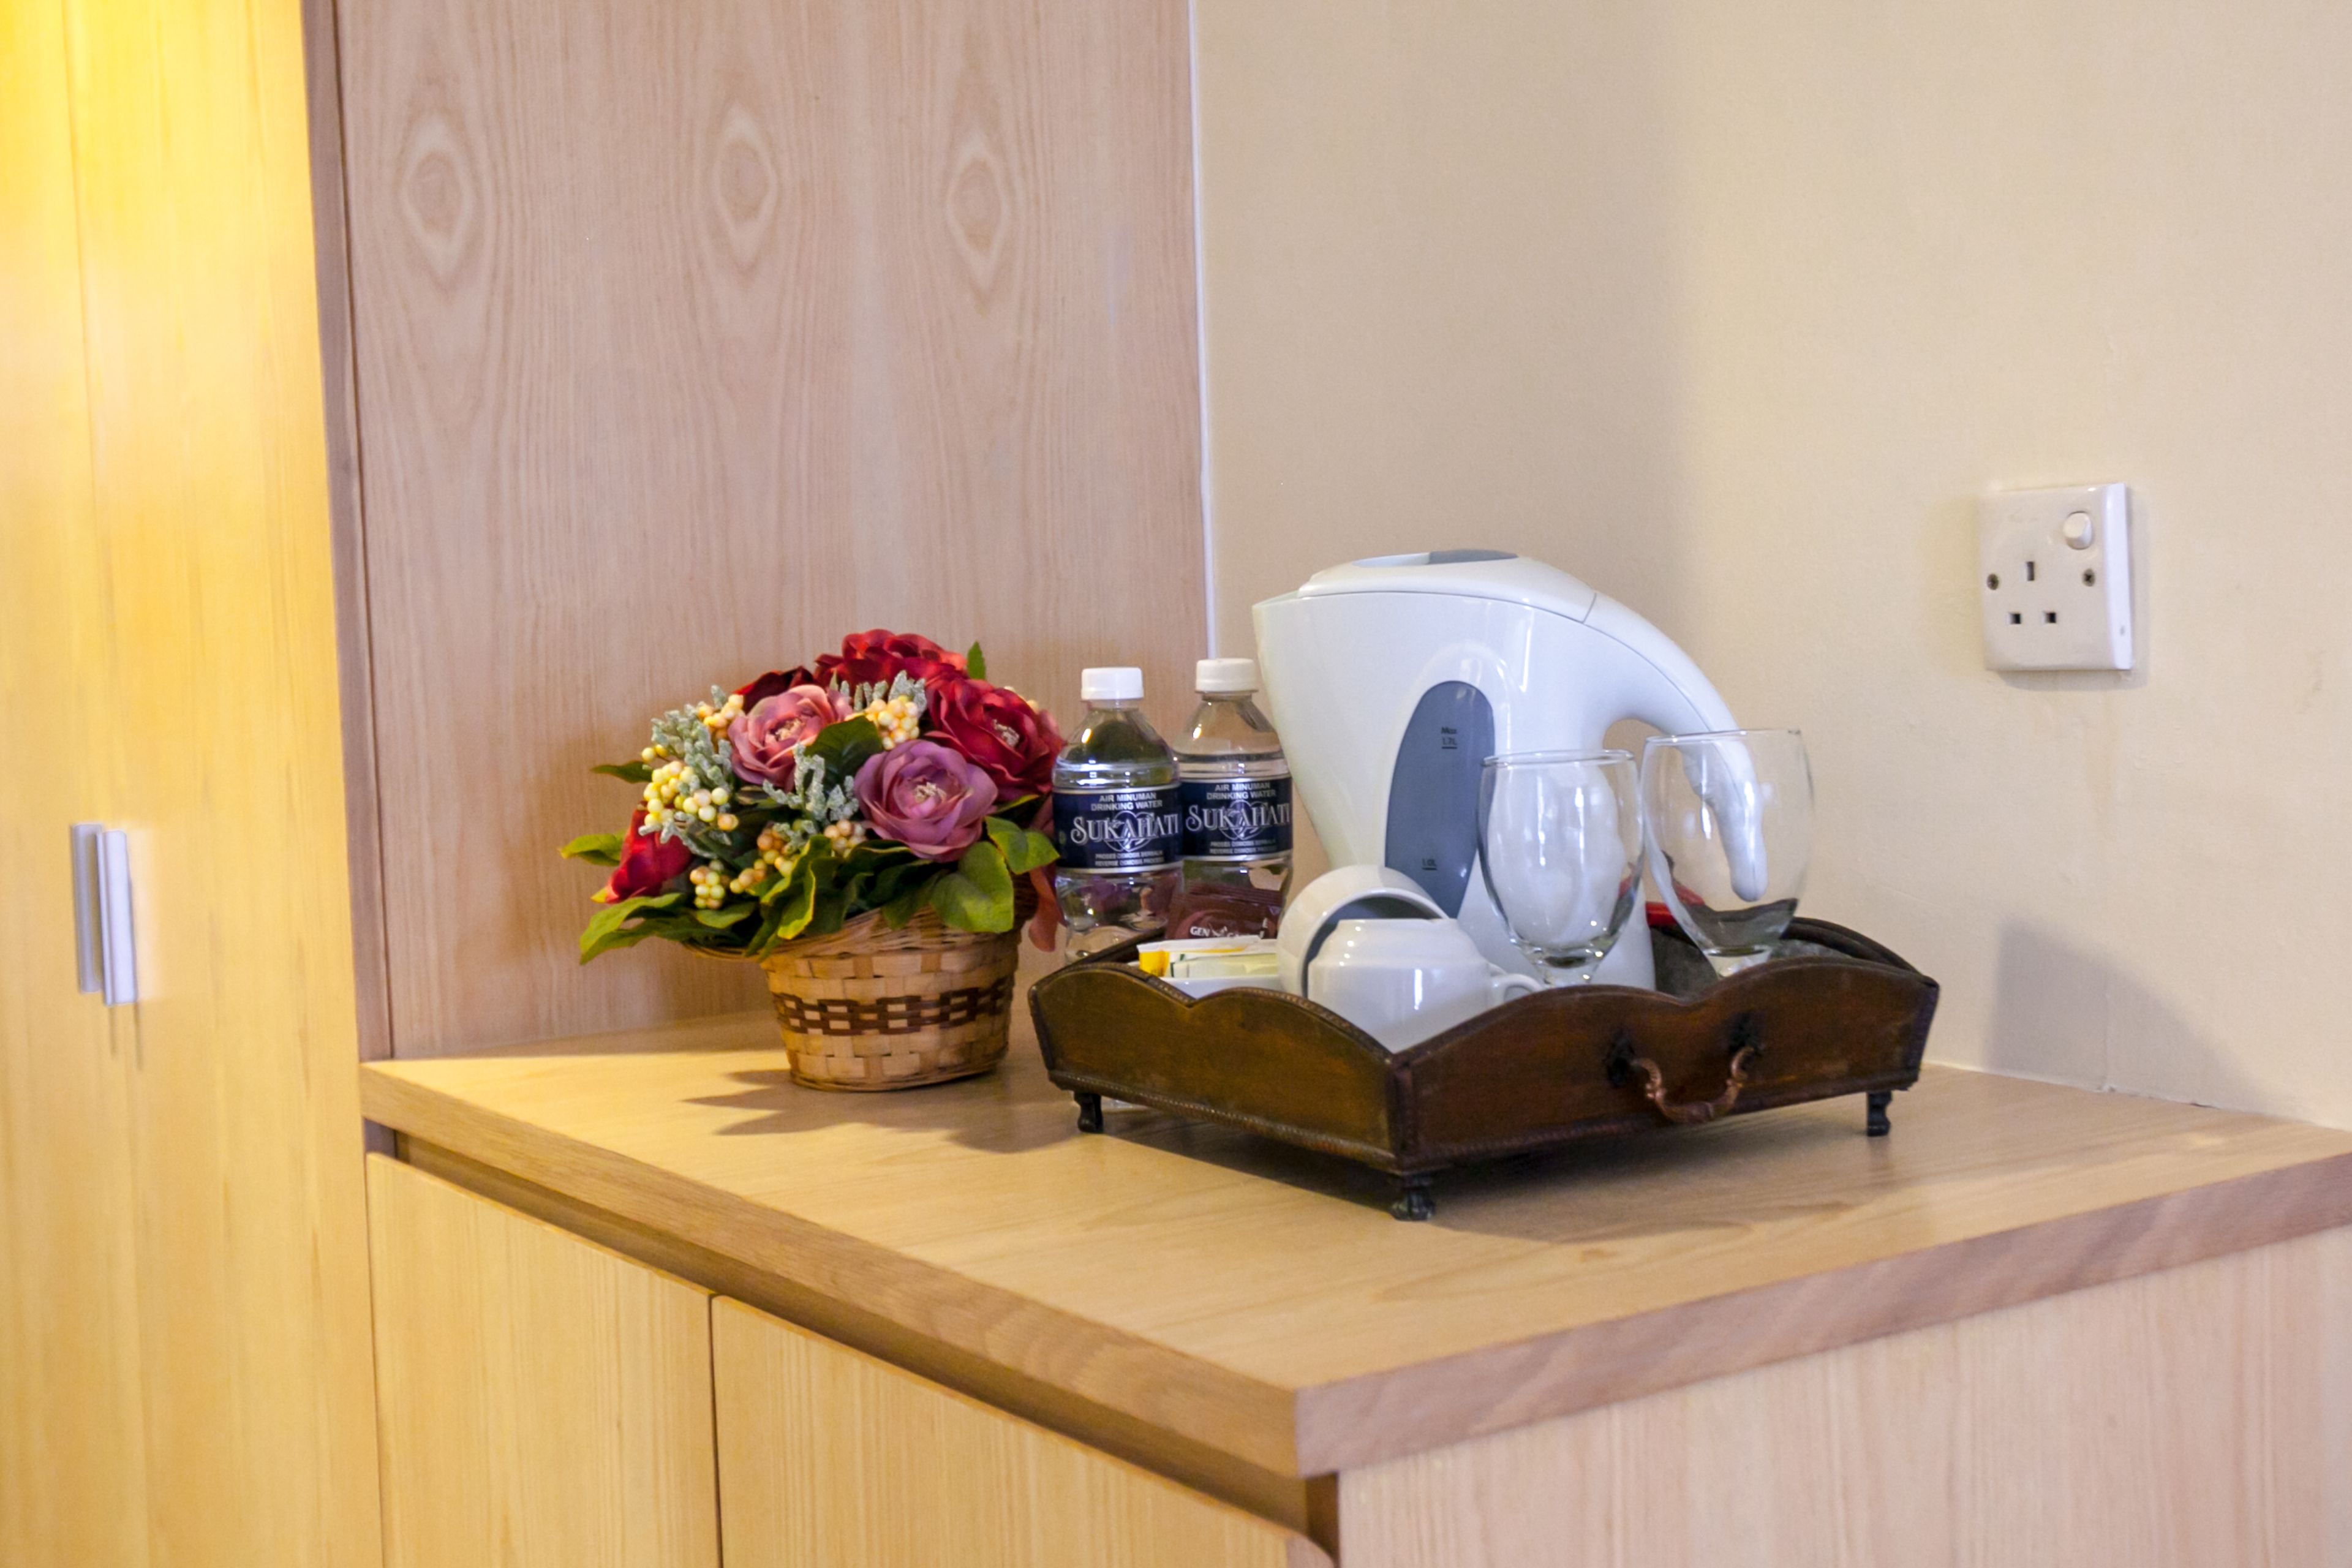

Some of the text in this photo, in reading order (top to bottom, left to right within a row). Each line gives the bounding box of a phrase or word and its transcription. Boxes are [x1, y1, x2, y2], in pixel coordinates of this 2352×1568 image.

[1232, 782, 1270, 791] MINUMAN
[1117, 792, 1156, 801] MINUMAN
[1207, 789, 1276, 800] DRINKING WATER
[1091, 799, 1163, 811] DRINKING WATER
